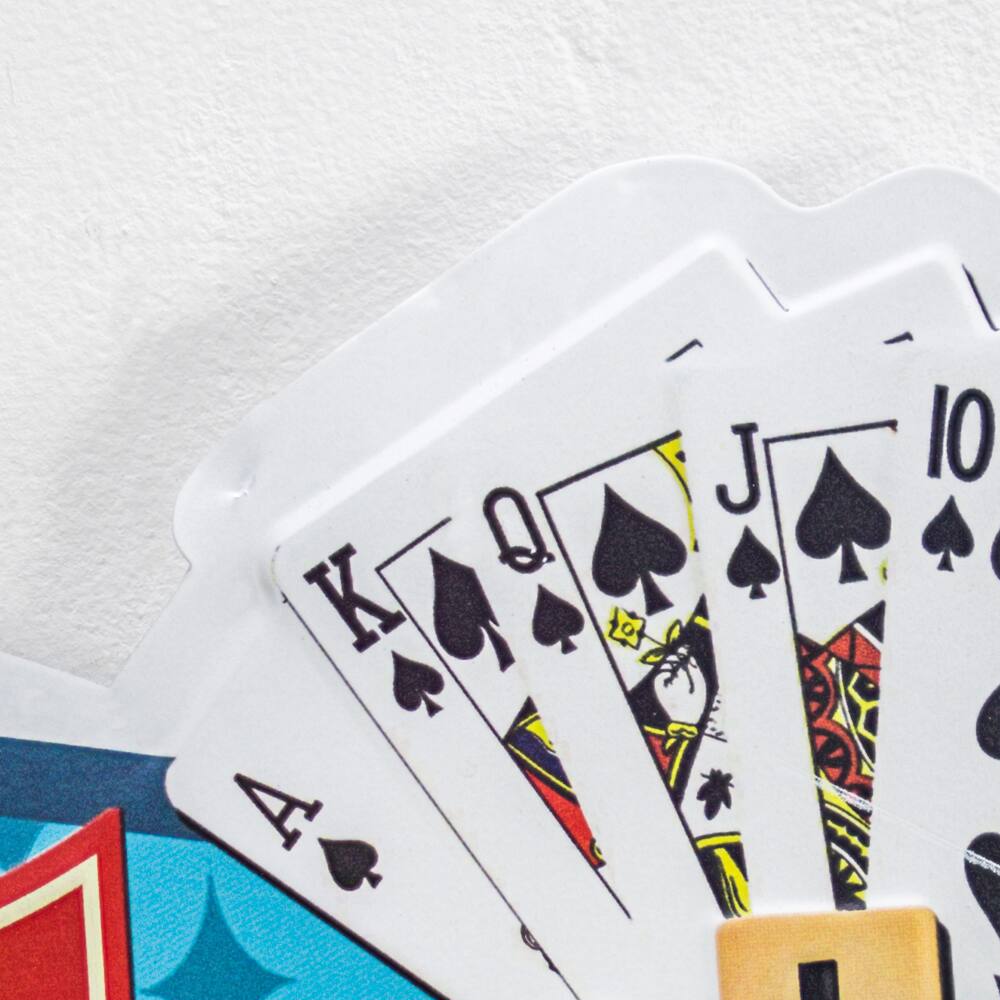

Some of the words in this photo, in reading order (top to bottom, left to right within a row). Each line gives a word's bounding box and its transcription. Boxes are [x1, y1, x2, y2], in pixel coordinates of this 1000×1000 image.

[715, 422, 759, 515] J
[927, 384, 995, 483] 10
[483, 486, 556, 574] Q
[303, 543, 407, 653] K
[233, 773, 323, 851] A
